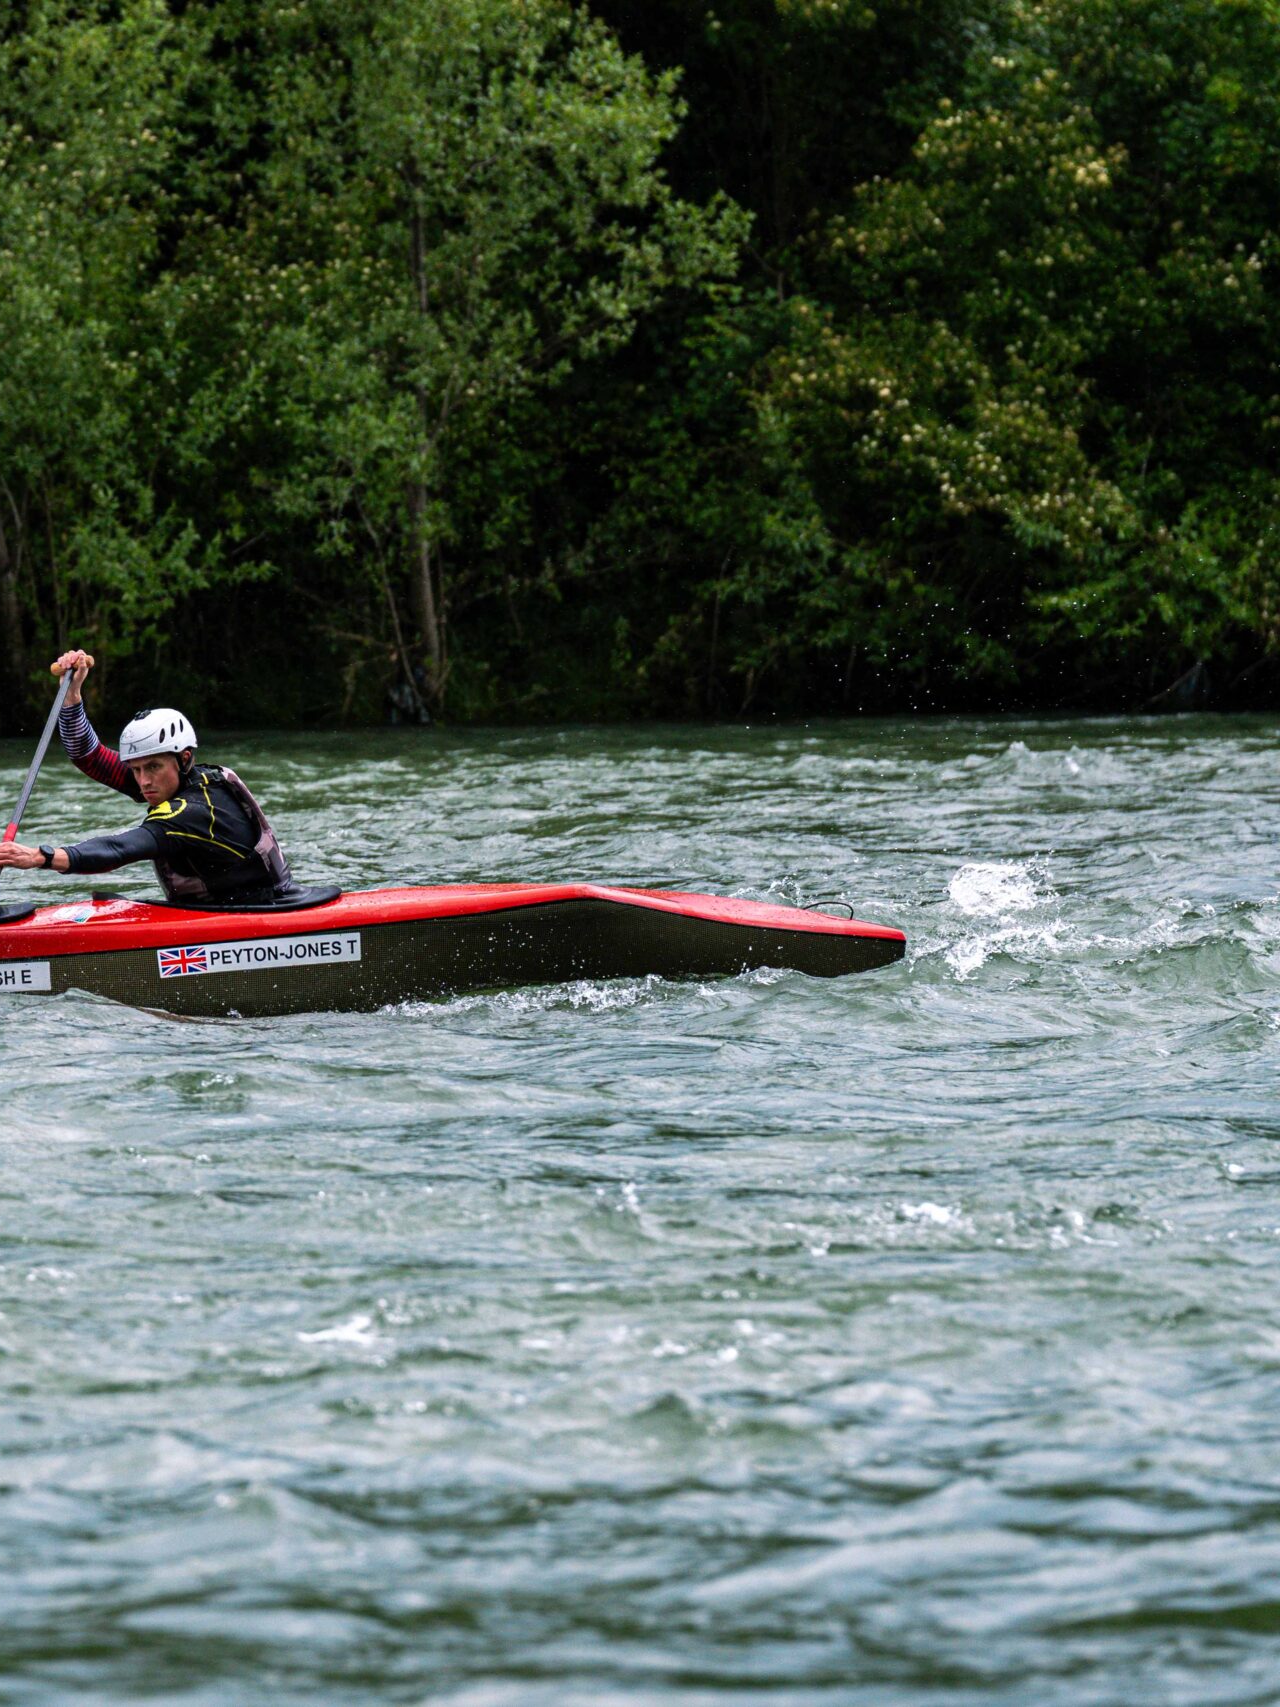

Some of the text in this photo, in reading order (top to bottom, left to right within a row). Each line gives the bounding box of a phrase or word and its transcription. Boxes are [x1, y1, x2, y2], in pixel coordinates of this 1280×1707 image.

[210, 939, 358, 966] PEYTON-JONES T
[21, 969, 32, 984] E
